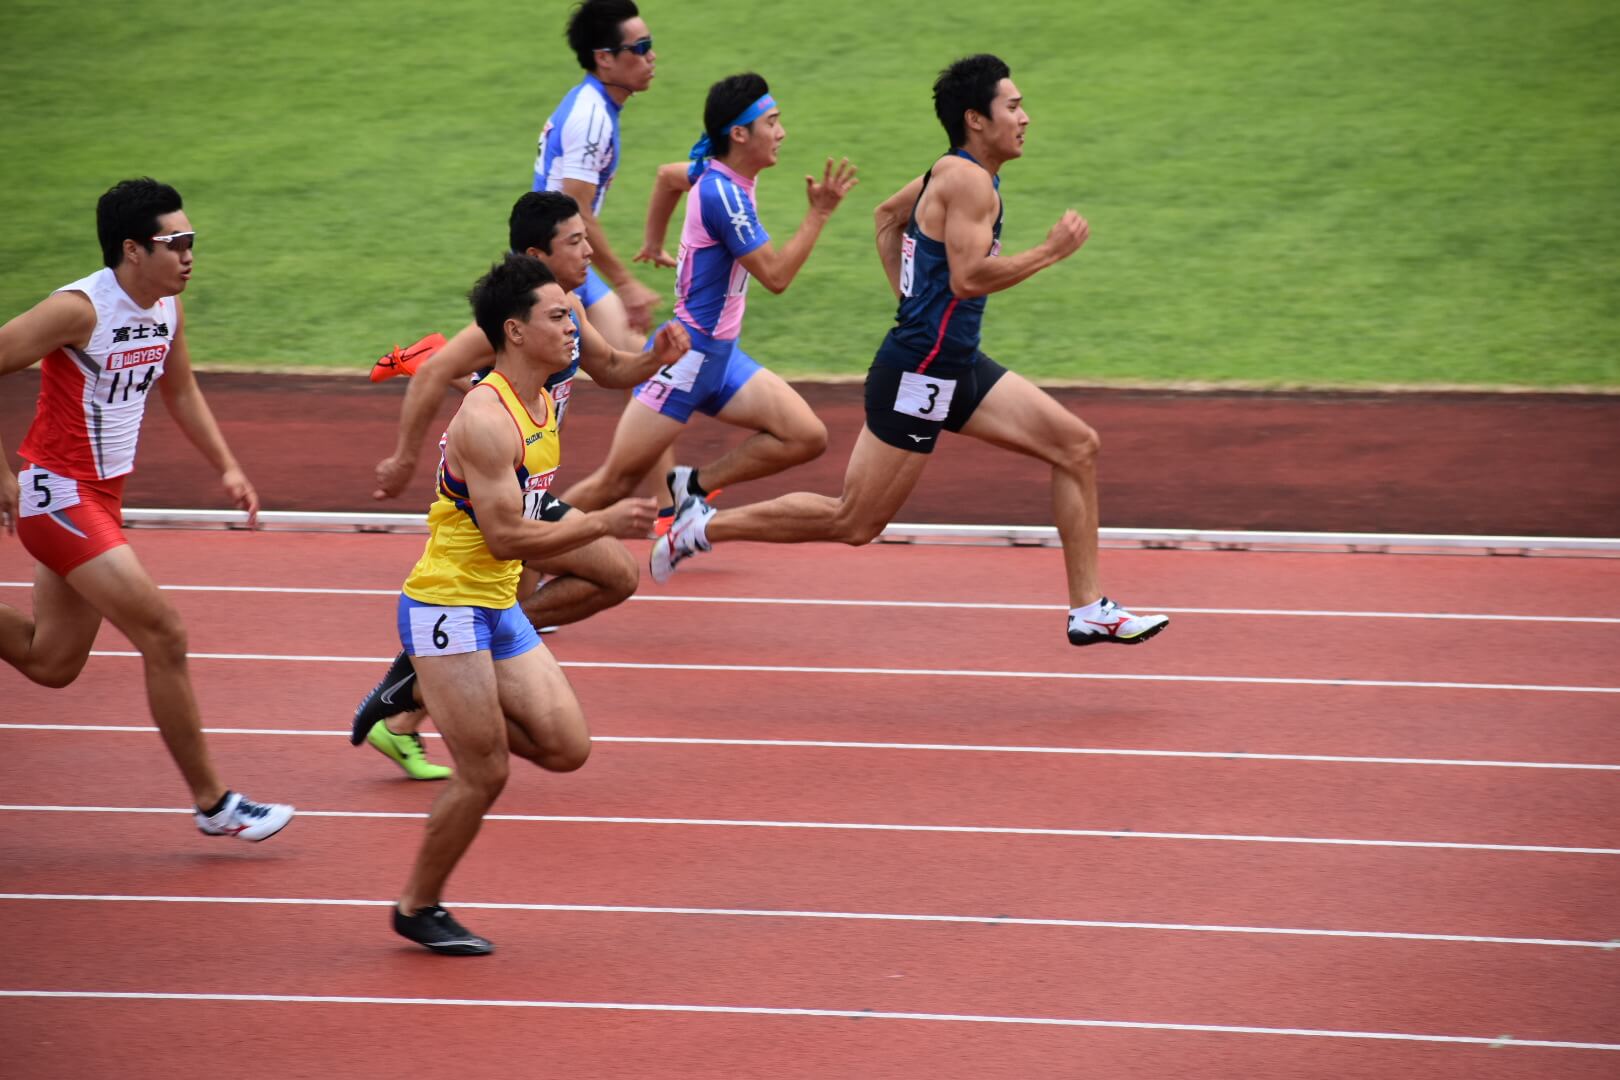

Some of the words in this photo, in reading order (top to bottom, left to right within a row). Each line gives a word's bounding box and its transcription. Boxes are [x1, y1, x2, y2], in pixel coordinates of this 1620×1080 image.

[112, 323, 168, 343] 富士通
[107, 365, 155, 404] 114
[918, 383, 939, 414] 3
[33, 474, 52, 509] 5
[432, 613, 449, 650] 6
